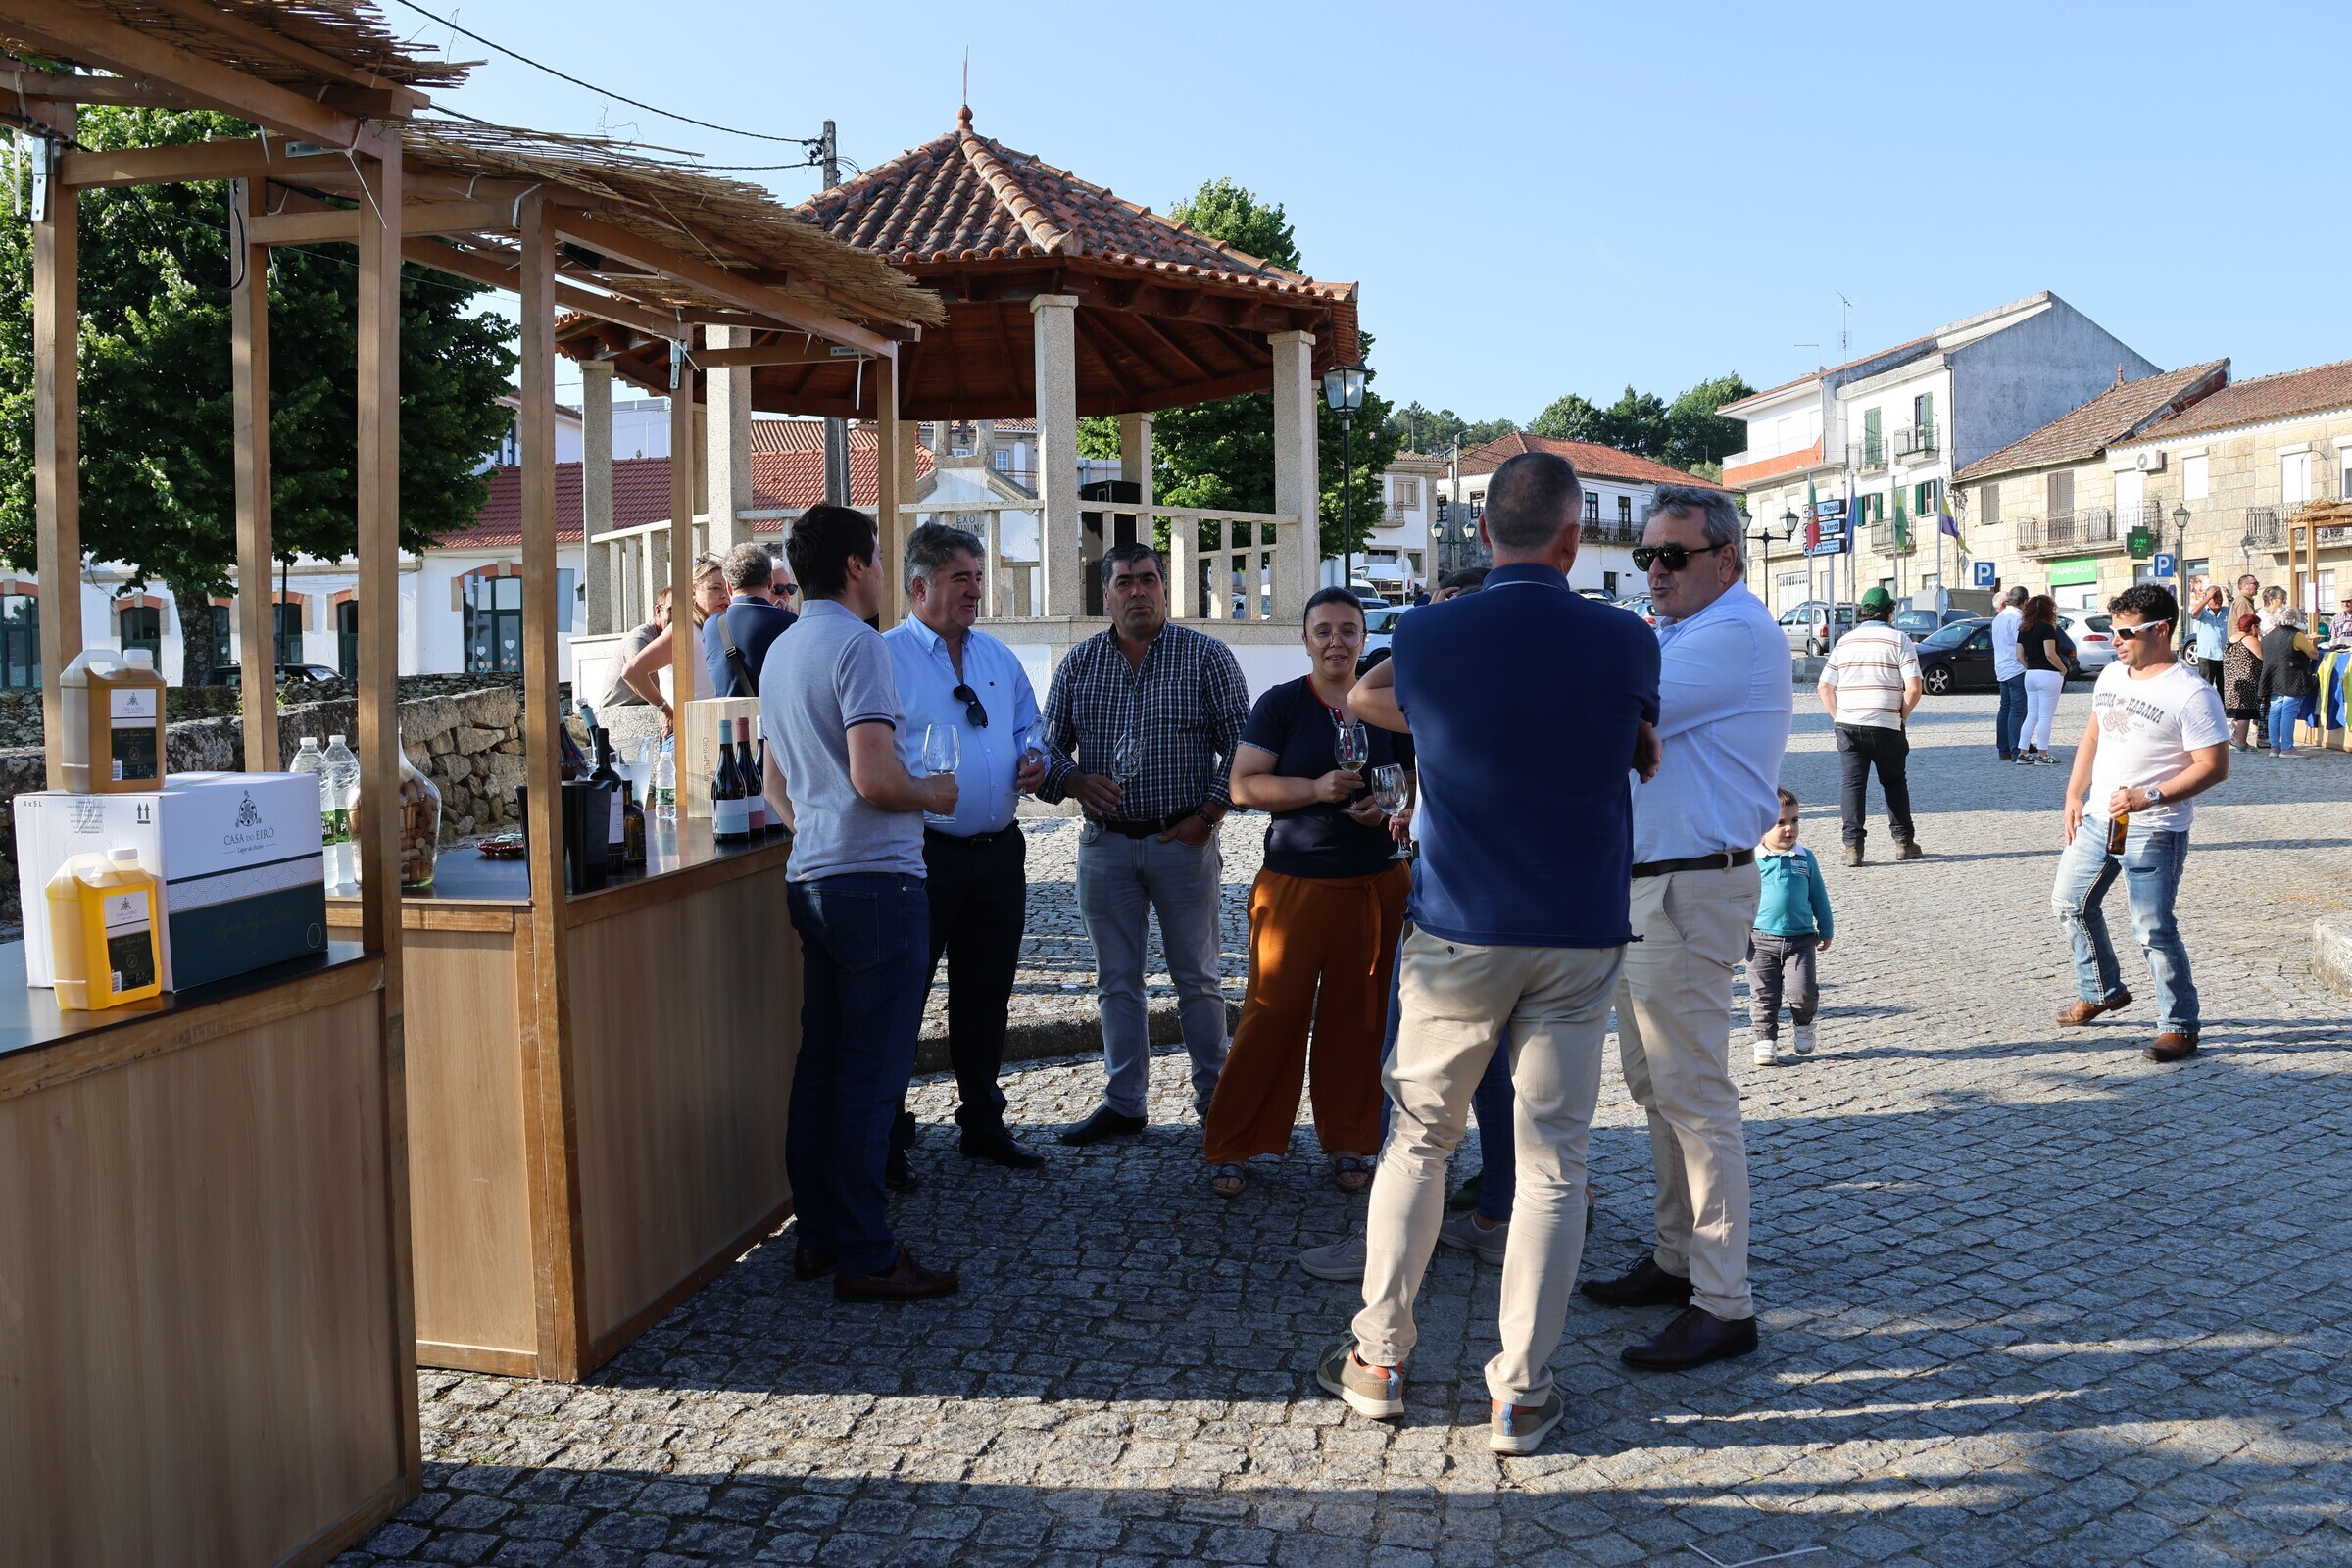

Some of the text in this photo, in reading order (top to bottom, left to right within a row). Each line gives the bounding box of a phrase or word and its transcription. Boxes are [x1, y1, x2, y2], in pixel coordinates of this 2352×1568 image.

[1824, 504, 1839, 513] Pópulo
[956, 514, 976, 524] EXO
[1978, 564, 1991, 585] P
[2157, 556, 2170, 576] P
[2126, 697, 2165, 724] HABANA
[223, 833, 245, 846] CASA
[255, 826, 275, 840] EIRÓ
